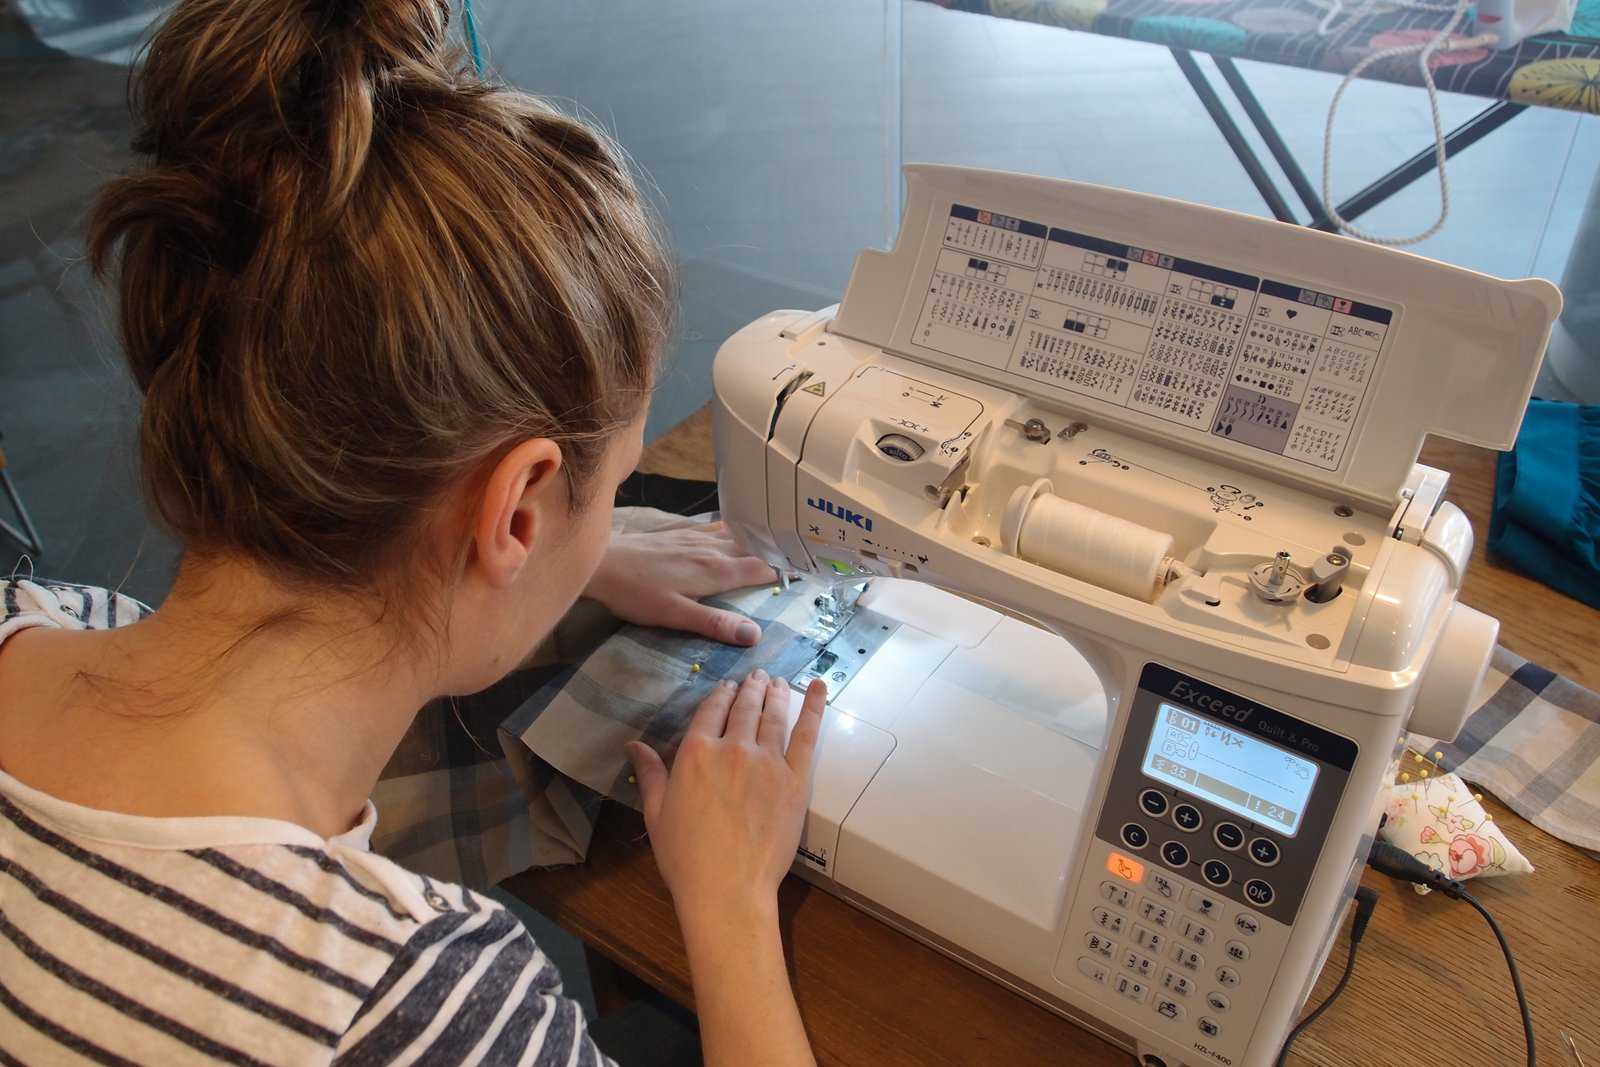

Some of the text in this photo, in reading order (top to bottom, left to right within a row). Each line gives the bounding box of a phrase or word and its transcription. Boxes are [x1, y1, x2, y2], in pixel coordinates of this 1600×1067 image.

[1348, 326, 1364, 337] ABC
[807, 497, 873, 532] JUKI
[1170, 680, 1320, 753] Exceed Quilt & Pro
[1181, 717, 1197, 731] 01
[1267, 805, 1286, 821] 2.4
[1130, 831, 1139, 842] C
[1248, 885, 1268, 901] OK
[1160, 910, 1166, 918] 2
[1198, 928, 1206, 936] 3
[1190, 954, 1197, 962] 6
[1193, 1042, 1232, 1066] HZL-F400
